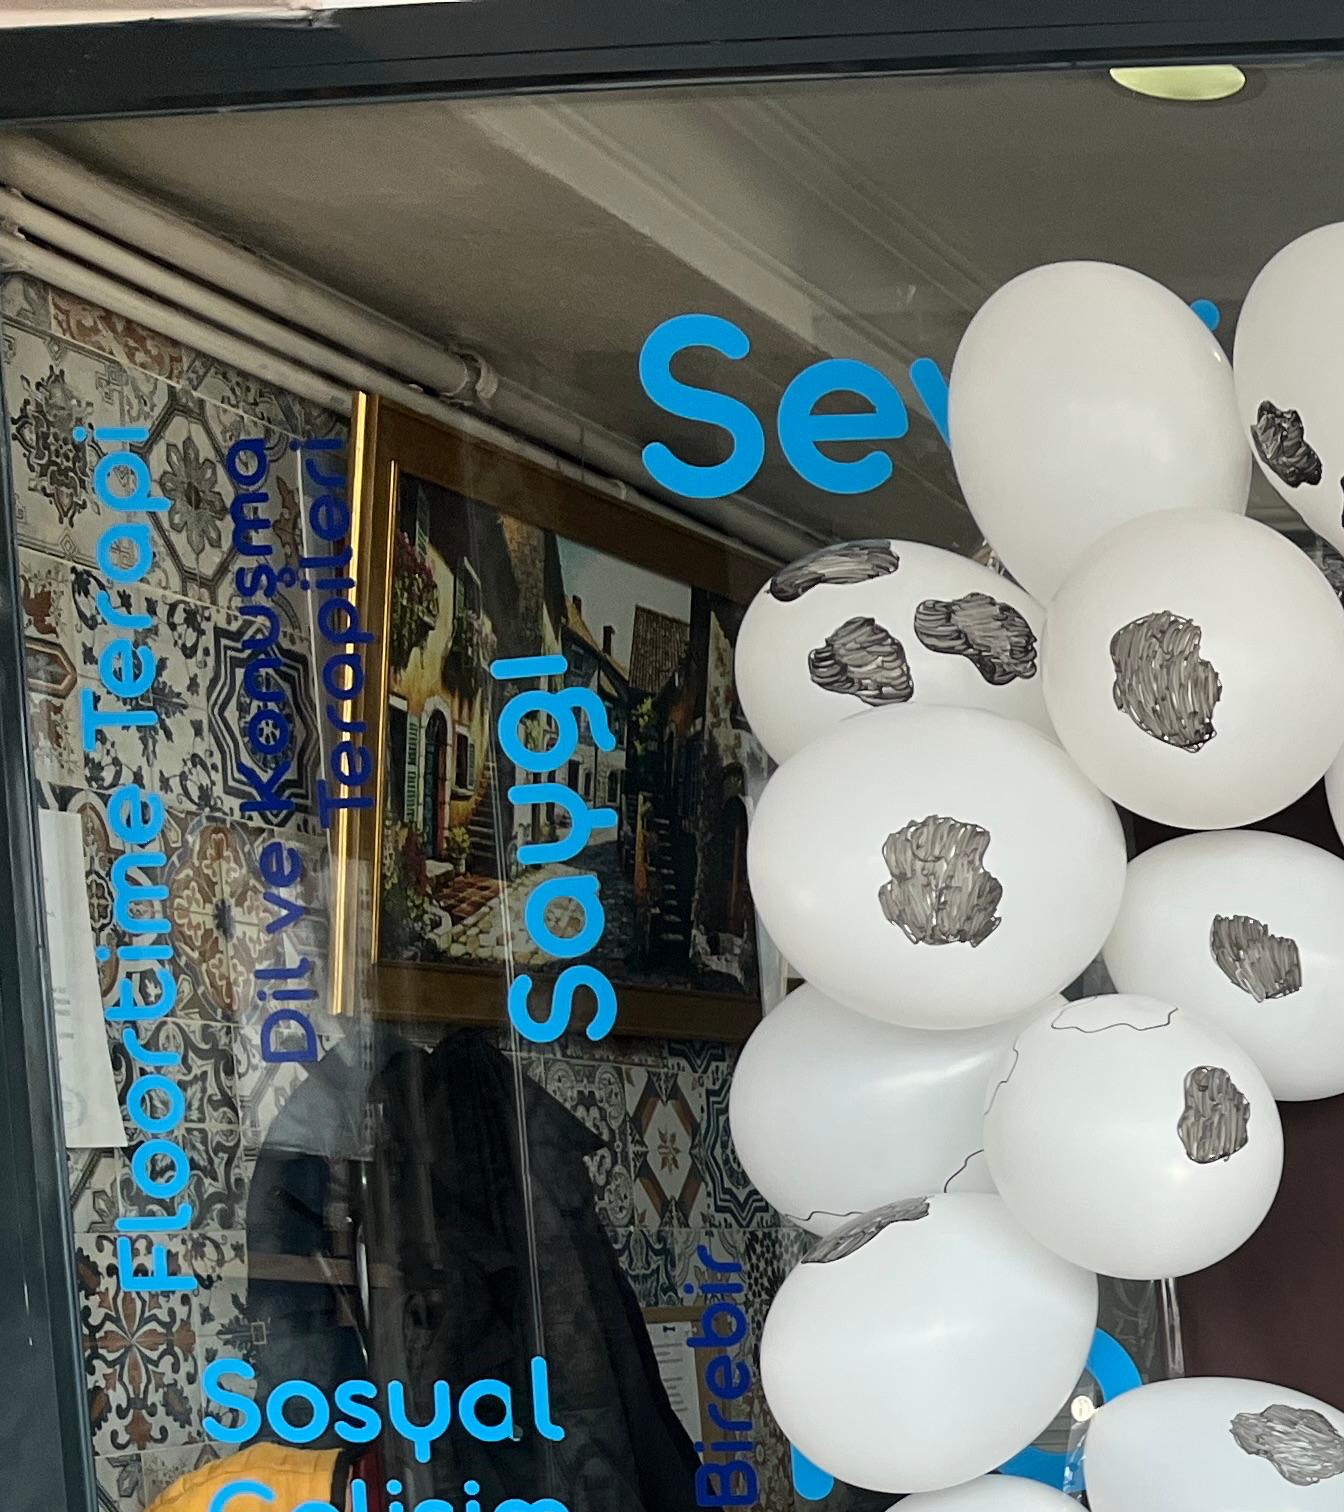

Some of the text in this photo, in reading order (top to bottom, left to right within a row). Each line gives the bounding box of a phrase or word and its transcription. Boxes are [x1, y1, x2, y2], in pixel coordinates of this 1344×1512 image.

[225, 437, 318, 1063] Dil ve Konuşma
[291, 436, 376, 829] Terapileri
[73, 425, 199, 1293] Floortime Terapi
[201, 1356, 567, 1464] Sosyal
[683, 1243, 760, 1507] Birebir
